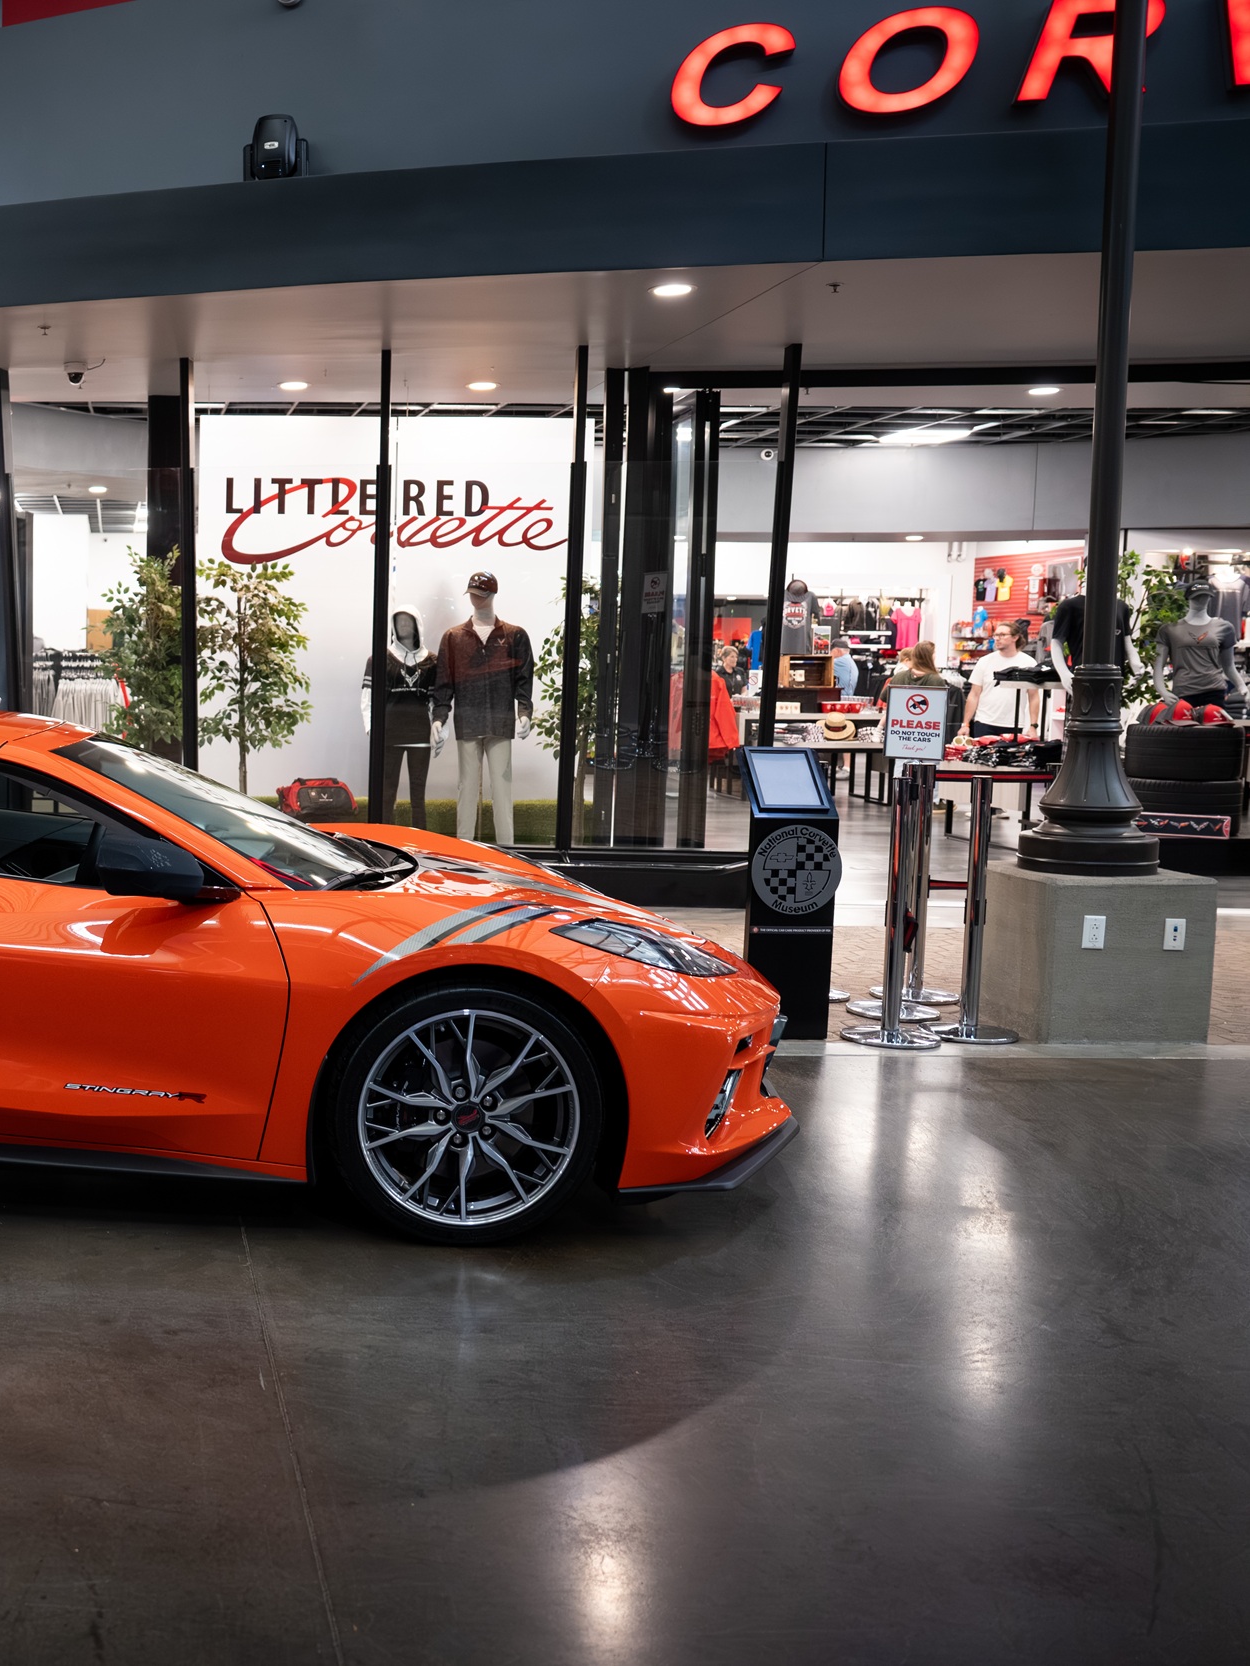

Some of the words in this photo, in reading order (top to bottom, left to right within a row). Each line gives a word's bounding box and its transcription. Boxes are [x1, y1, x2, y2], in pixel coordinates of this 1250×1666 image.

[670, 0, 1250, 127] COR
[225, 477, 377, 516] LITTLE
[403, 479, 490, 517] RED
[891, 719, 941, 731] PLEASE
[757, 826, 798, 857] National
[799, 826, 837, 859] Corvette
[771, 899, 819, 914] Museum
[64, 1083, 180, 1099] STINGRAY
